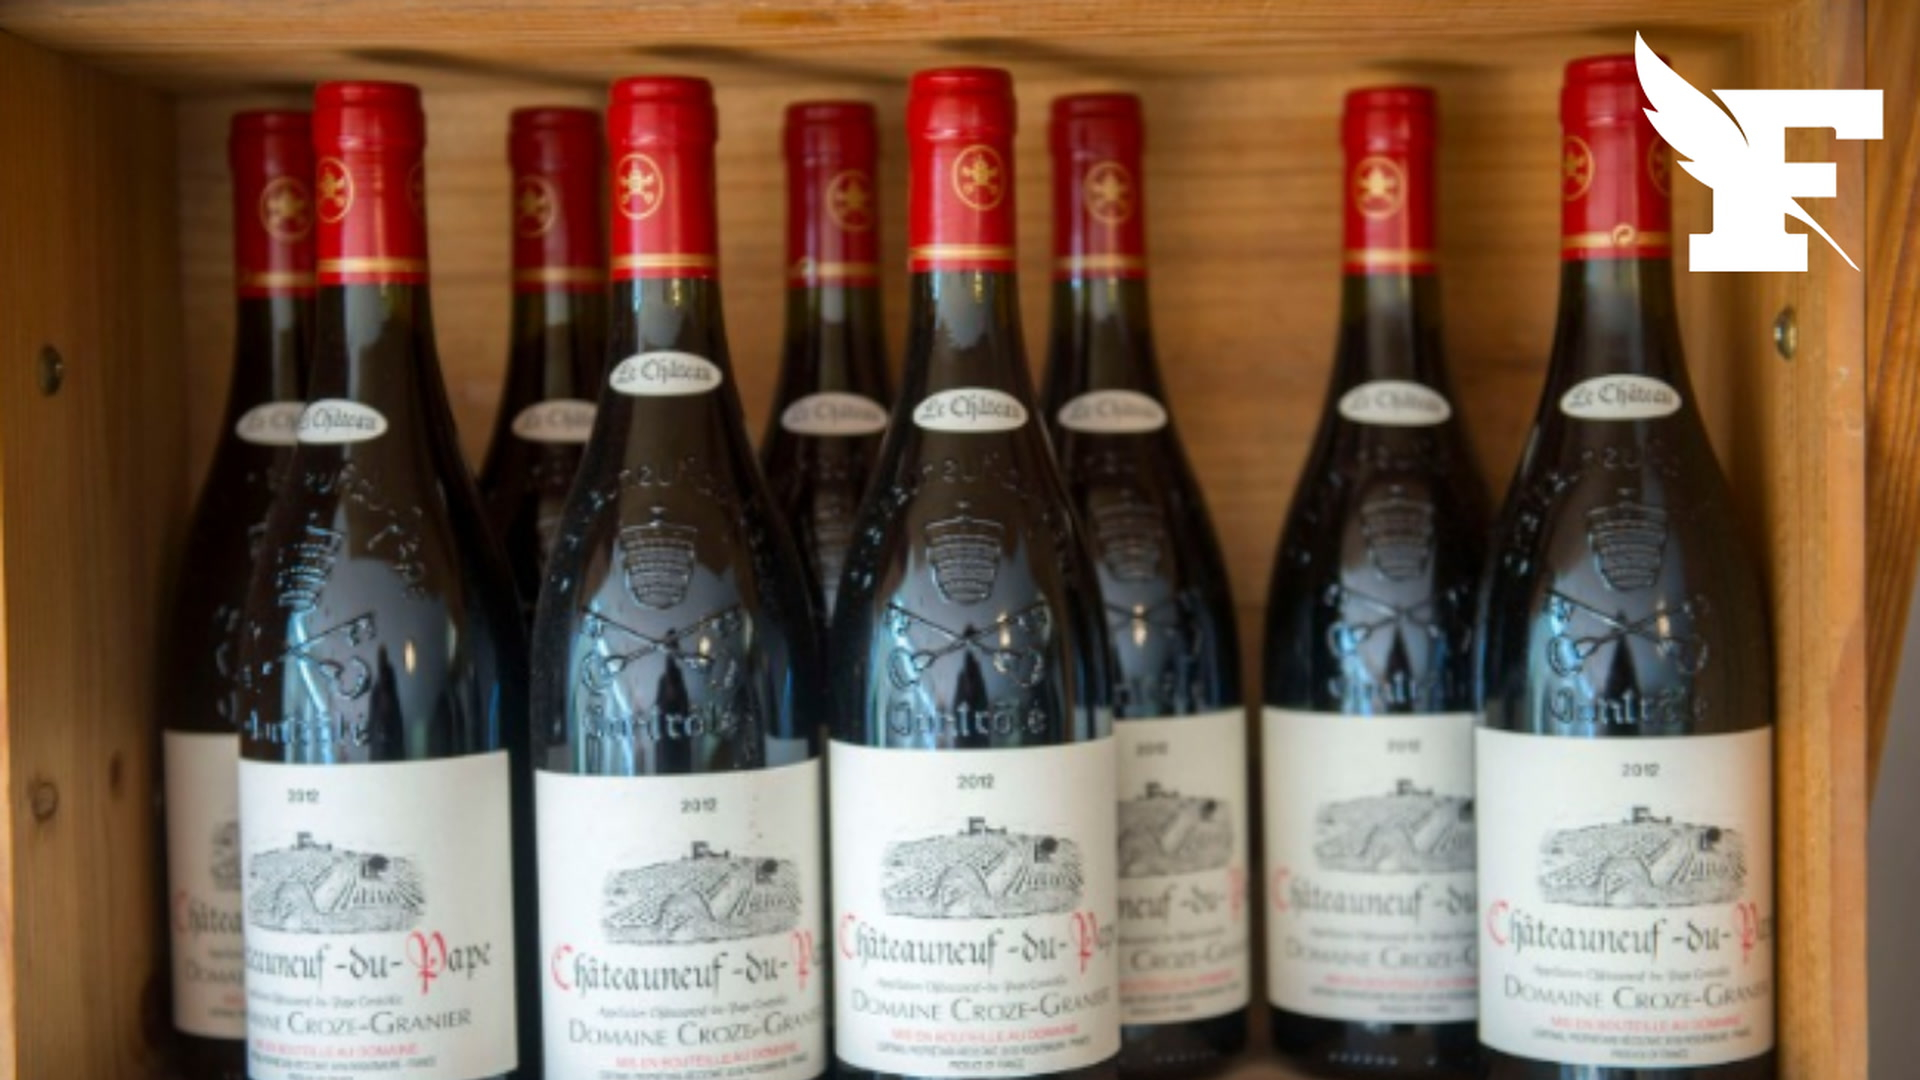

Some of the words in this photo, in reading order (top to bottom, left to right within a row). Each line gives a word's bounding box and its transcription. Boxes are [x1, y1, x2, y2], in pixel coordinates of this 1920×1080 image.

[919, 396, 944, 421] Le
[948, 392, 1022, 423] Château
[1598, 378, 1674, 408] Château
[957, 774, 995, 790] 2012
[1622, 763, 1660, 779] 2012
[288, 788, 320, 804] 2012
[681, 798, 717, 814] 2012
[851, 990, 946, 1022] DOMAINE
[1504, 974, 1603, 1010] DOMAINE
[569, 1017, 666, 1047] DOMAINE
